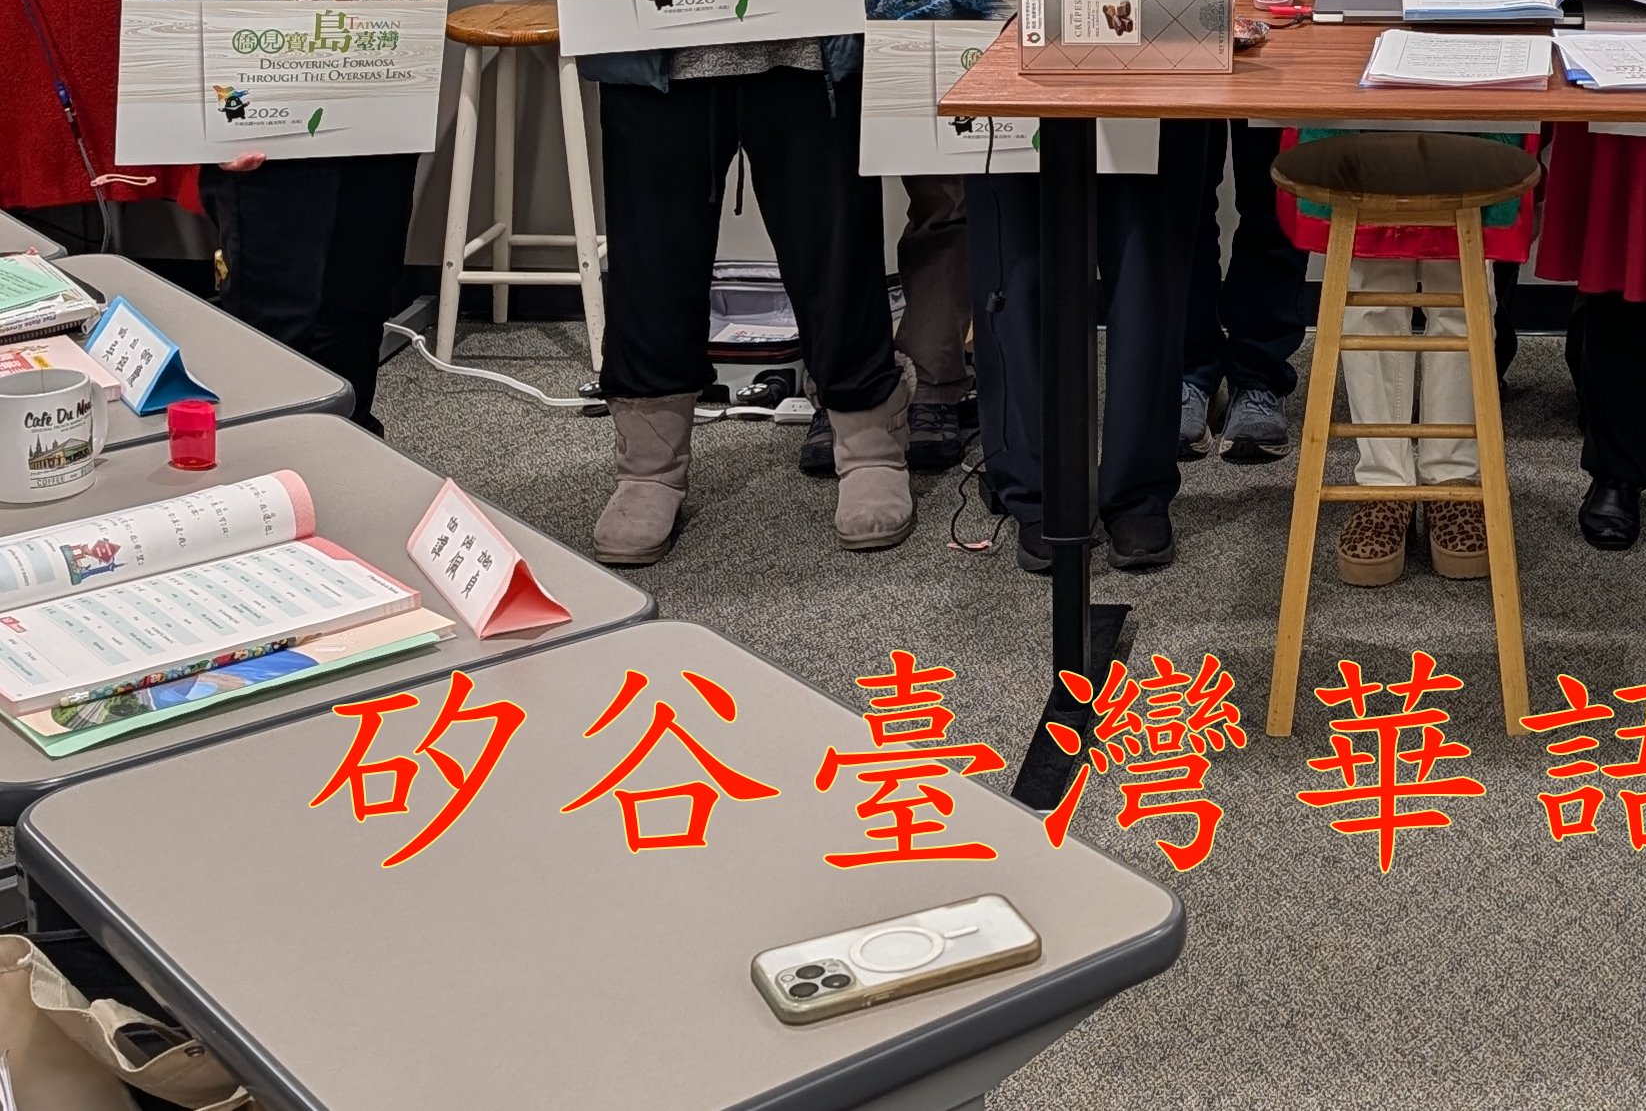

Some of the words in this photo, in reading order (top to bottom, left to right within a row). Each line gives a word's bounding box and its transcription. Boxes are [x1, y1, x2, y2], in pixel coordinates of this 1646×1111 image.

[346, 15, 401, 30] TAIWAN
[259, 57, 340, 71] DISCOVERING
[342, 56, 395, 68] FORMOSA
[237, 72, 299, 83] THROUGH
[301, 71, 326, 82] THE
[328, 70, 381, 82] OVERSEAS
[386, 68, 413, 80] LENS
[248, 107, 290, 119] 2026
[24, 411, 53, 428] Café
[57, 408, 73, 424] Du
[37, 476, 65, 487] COFFEE
